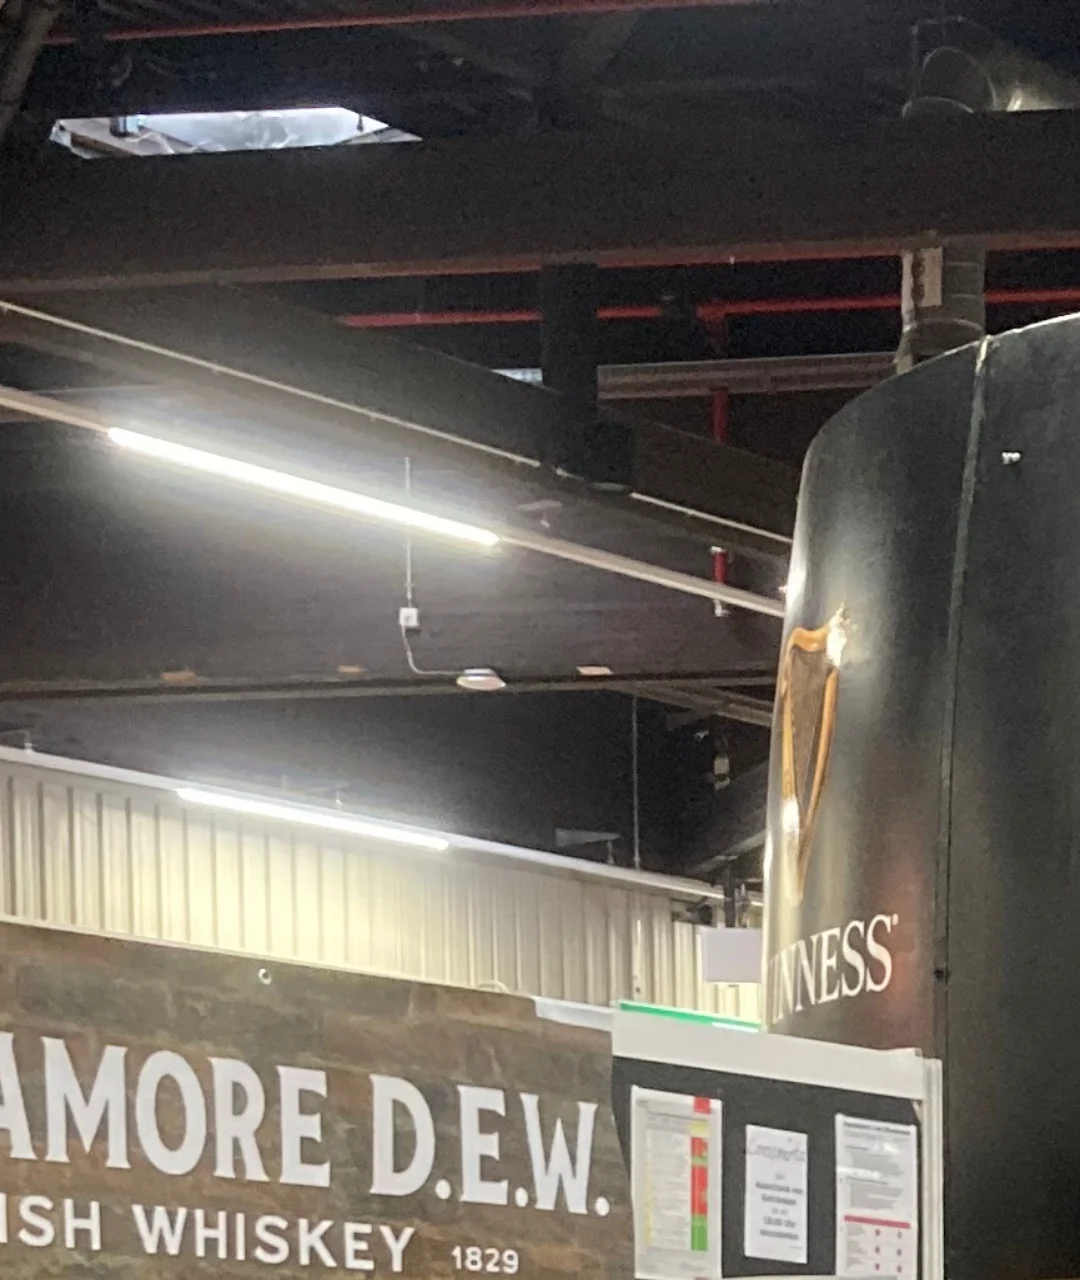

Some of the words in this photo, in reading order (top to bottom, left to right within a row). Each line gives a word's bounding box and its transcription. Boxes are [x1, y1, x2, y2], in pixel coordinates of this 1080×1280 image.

[370, 1073, 610, 1217] D.E.W.
[132, 1204, 416, 1273] WHISKEY
[451, 1246, 520, 1275] 1829
